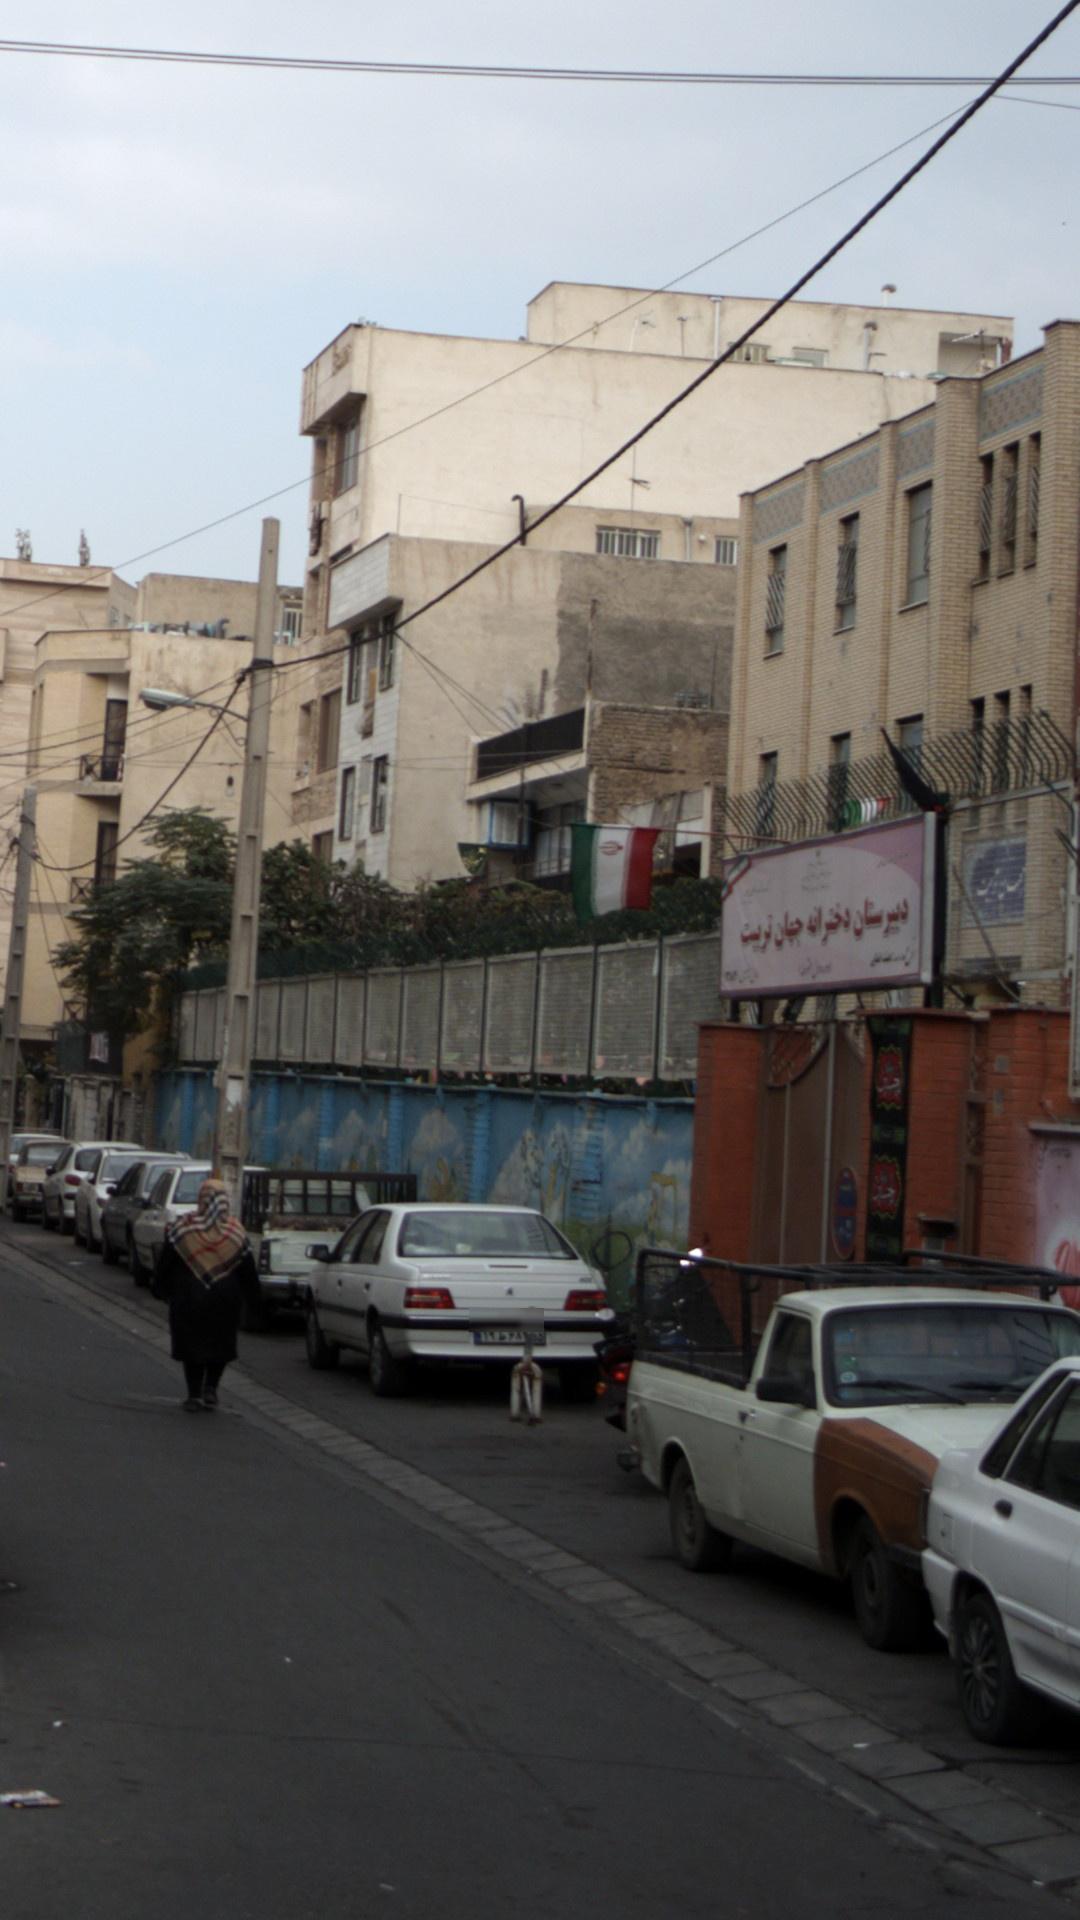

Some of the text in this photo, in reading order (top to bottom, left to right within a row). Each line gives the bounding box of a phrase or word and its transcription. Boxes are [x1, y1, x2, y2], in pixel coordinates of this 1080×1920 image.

[740, 897, 909, 953] دبیرستان دخترانه جهان تربیت
